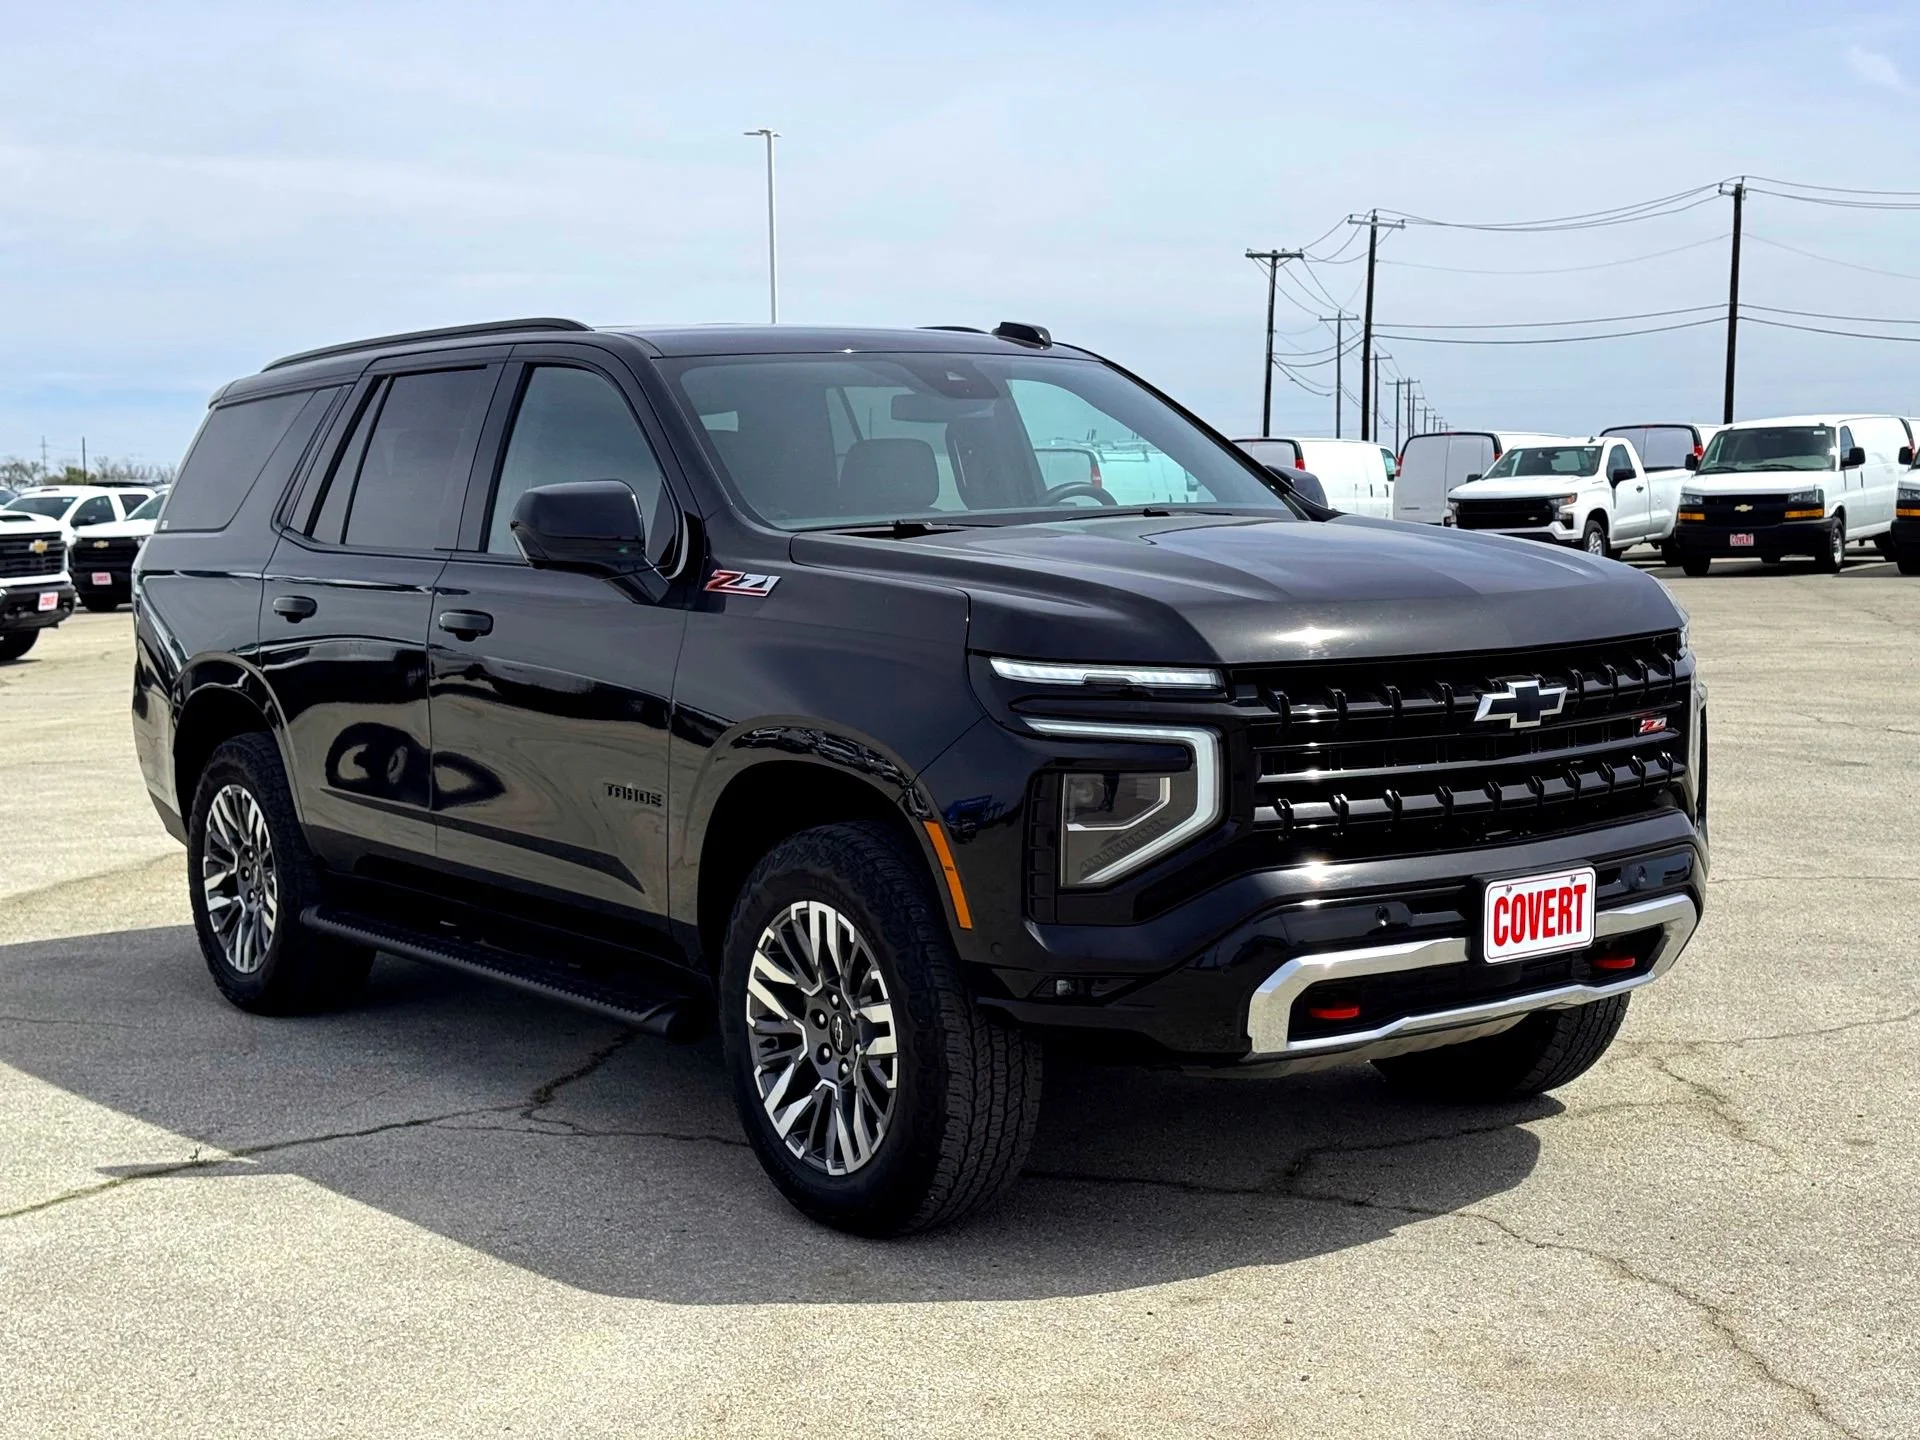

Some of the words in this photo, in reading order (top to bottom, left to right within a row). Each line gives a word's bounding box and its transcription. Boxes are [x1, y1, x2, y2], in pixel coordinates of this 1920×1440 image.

[703, 568, 782, 597] Z71
[603, 782, 663, 808] TAHOE
[1493, 883, 1587, 947] COVERT
